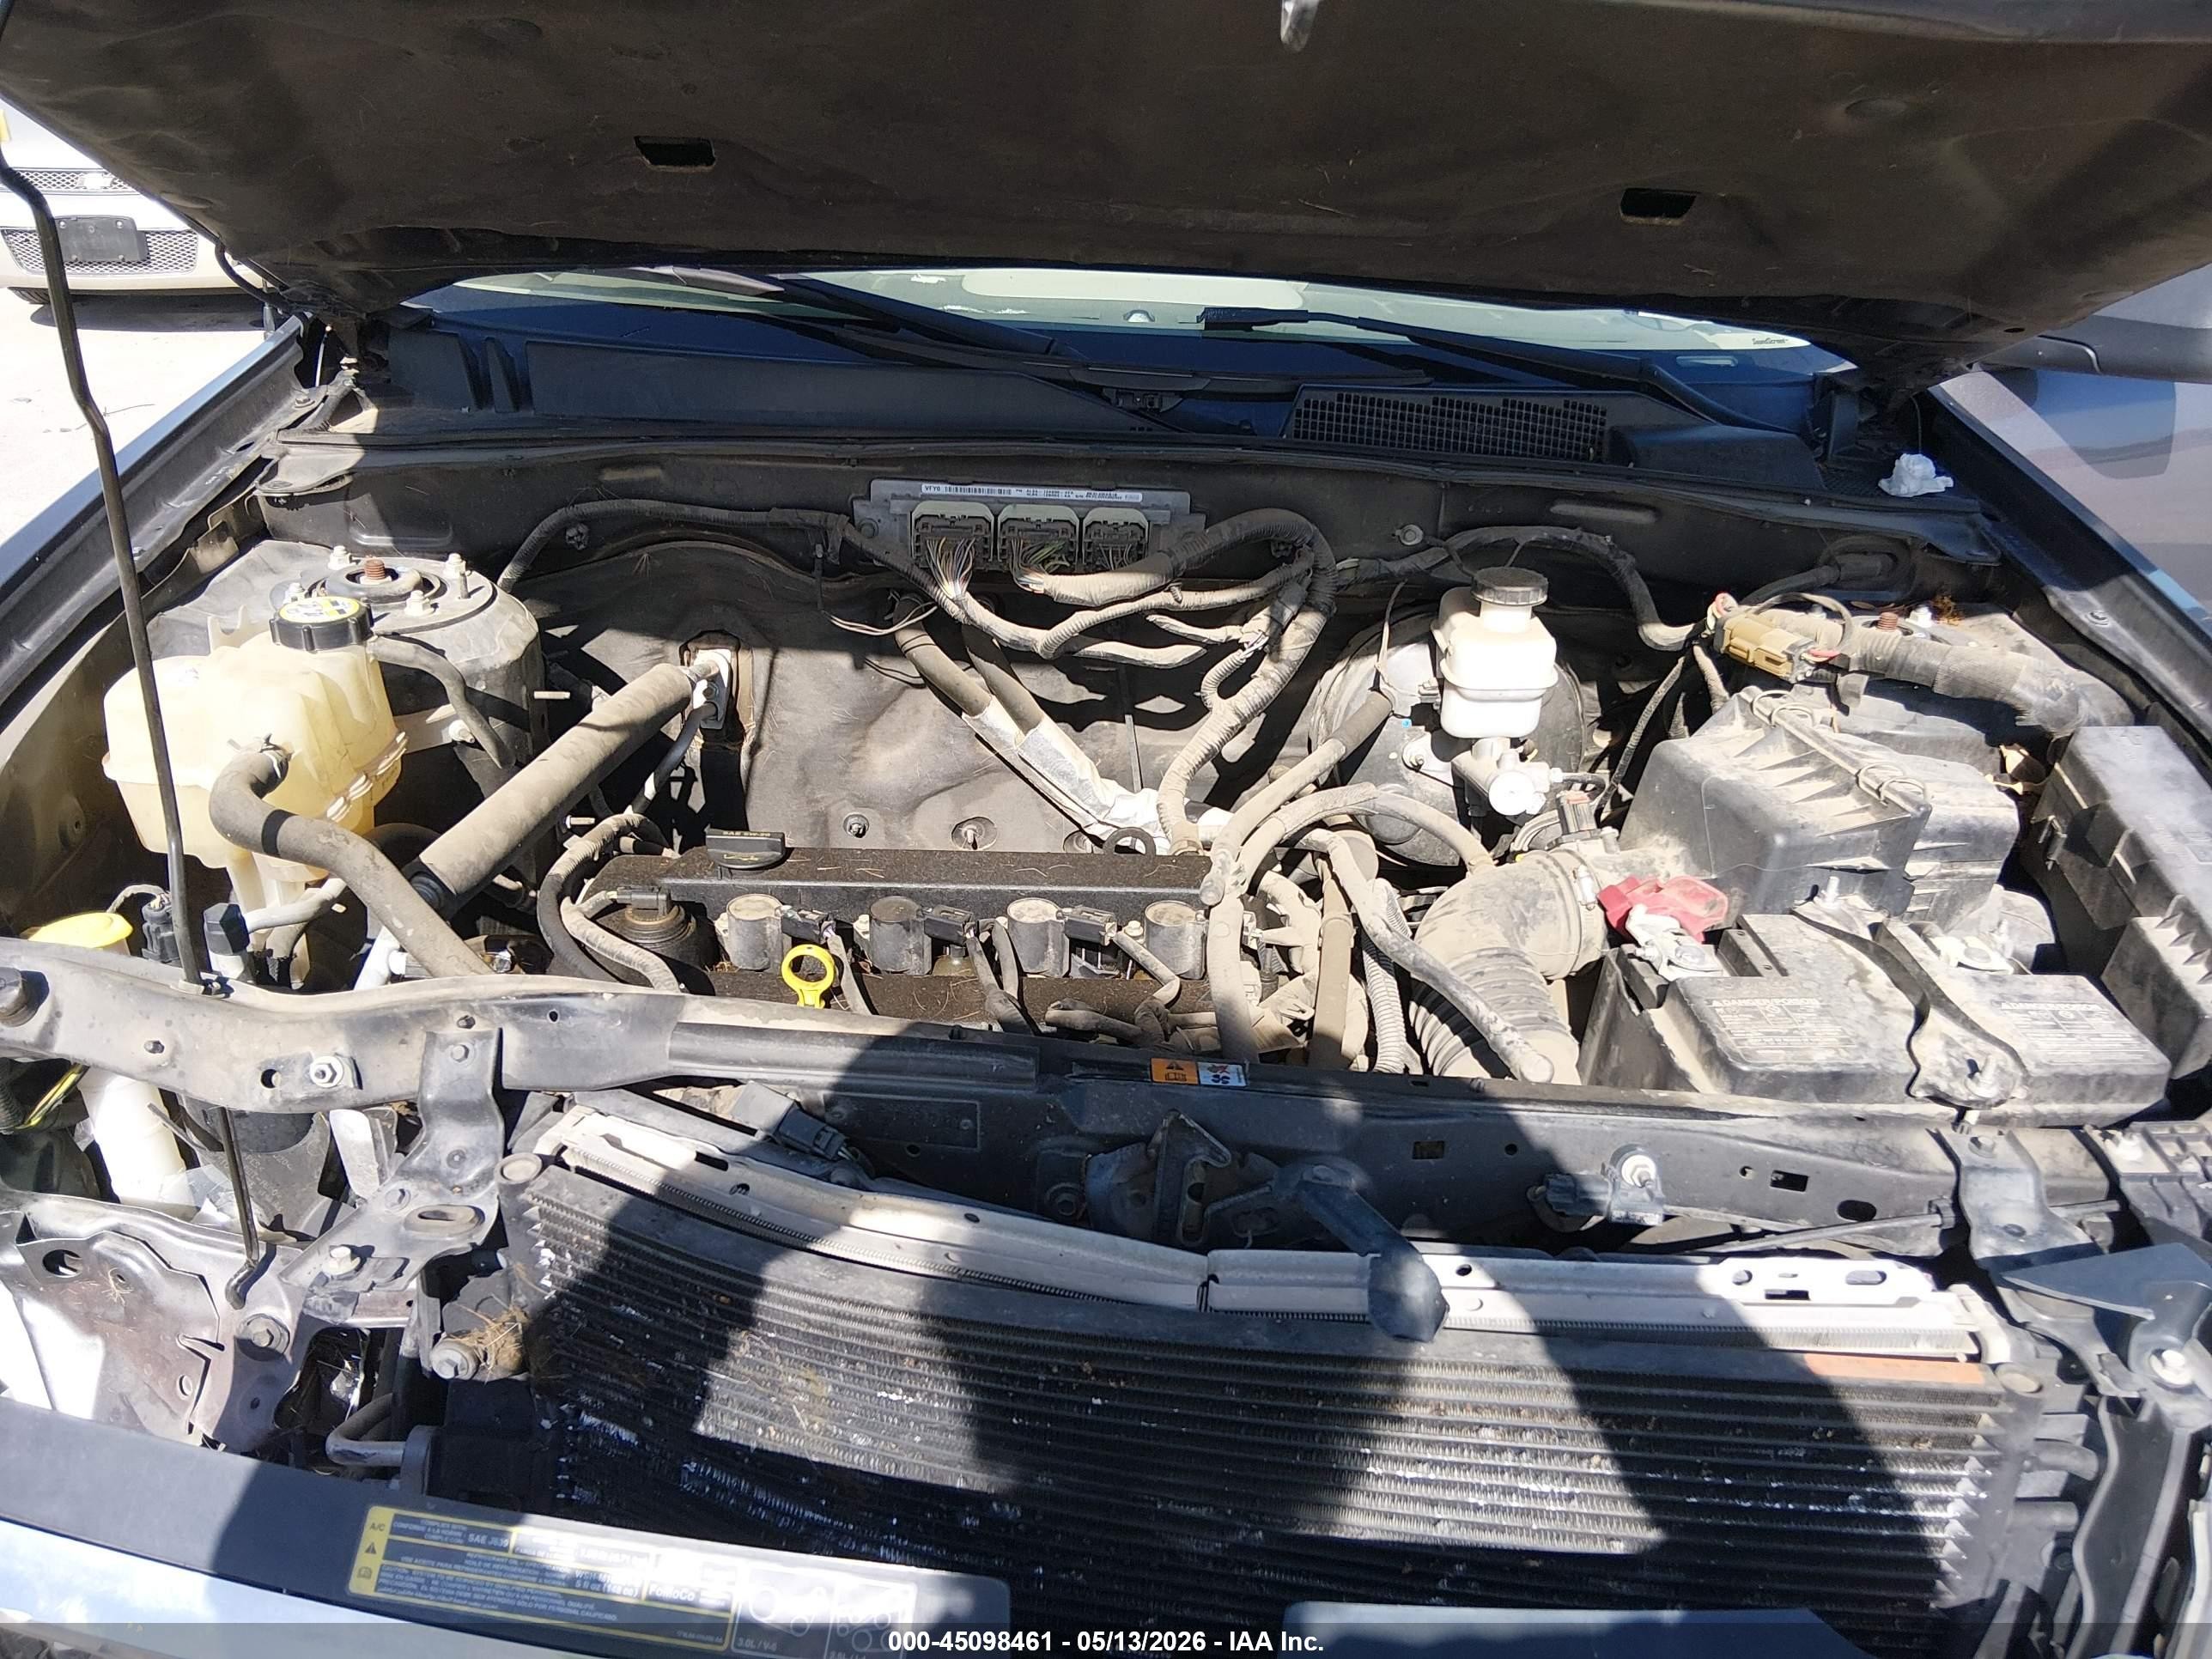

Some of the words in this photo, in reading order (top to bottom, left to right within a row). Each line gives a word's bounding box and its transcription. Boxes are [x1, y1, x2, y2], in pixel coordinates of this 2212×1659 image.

[369, 1522, 386, 1532] A/C
[467, 1534, 487, 1544] SAE
[648, 1584, 696, 1601] FoMoCo
